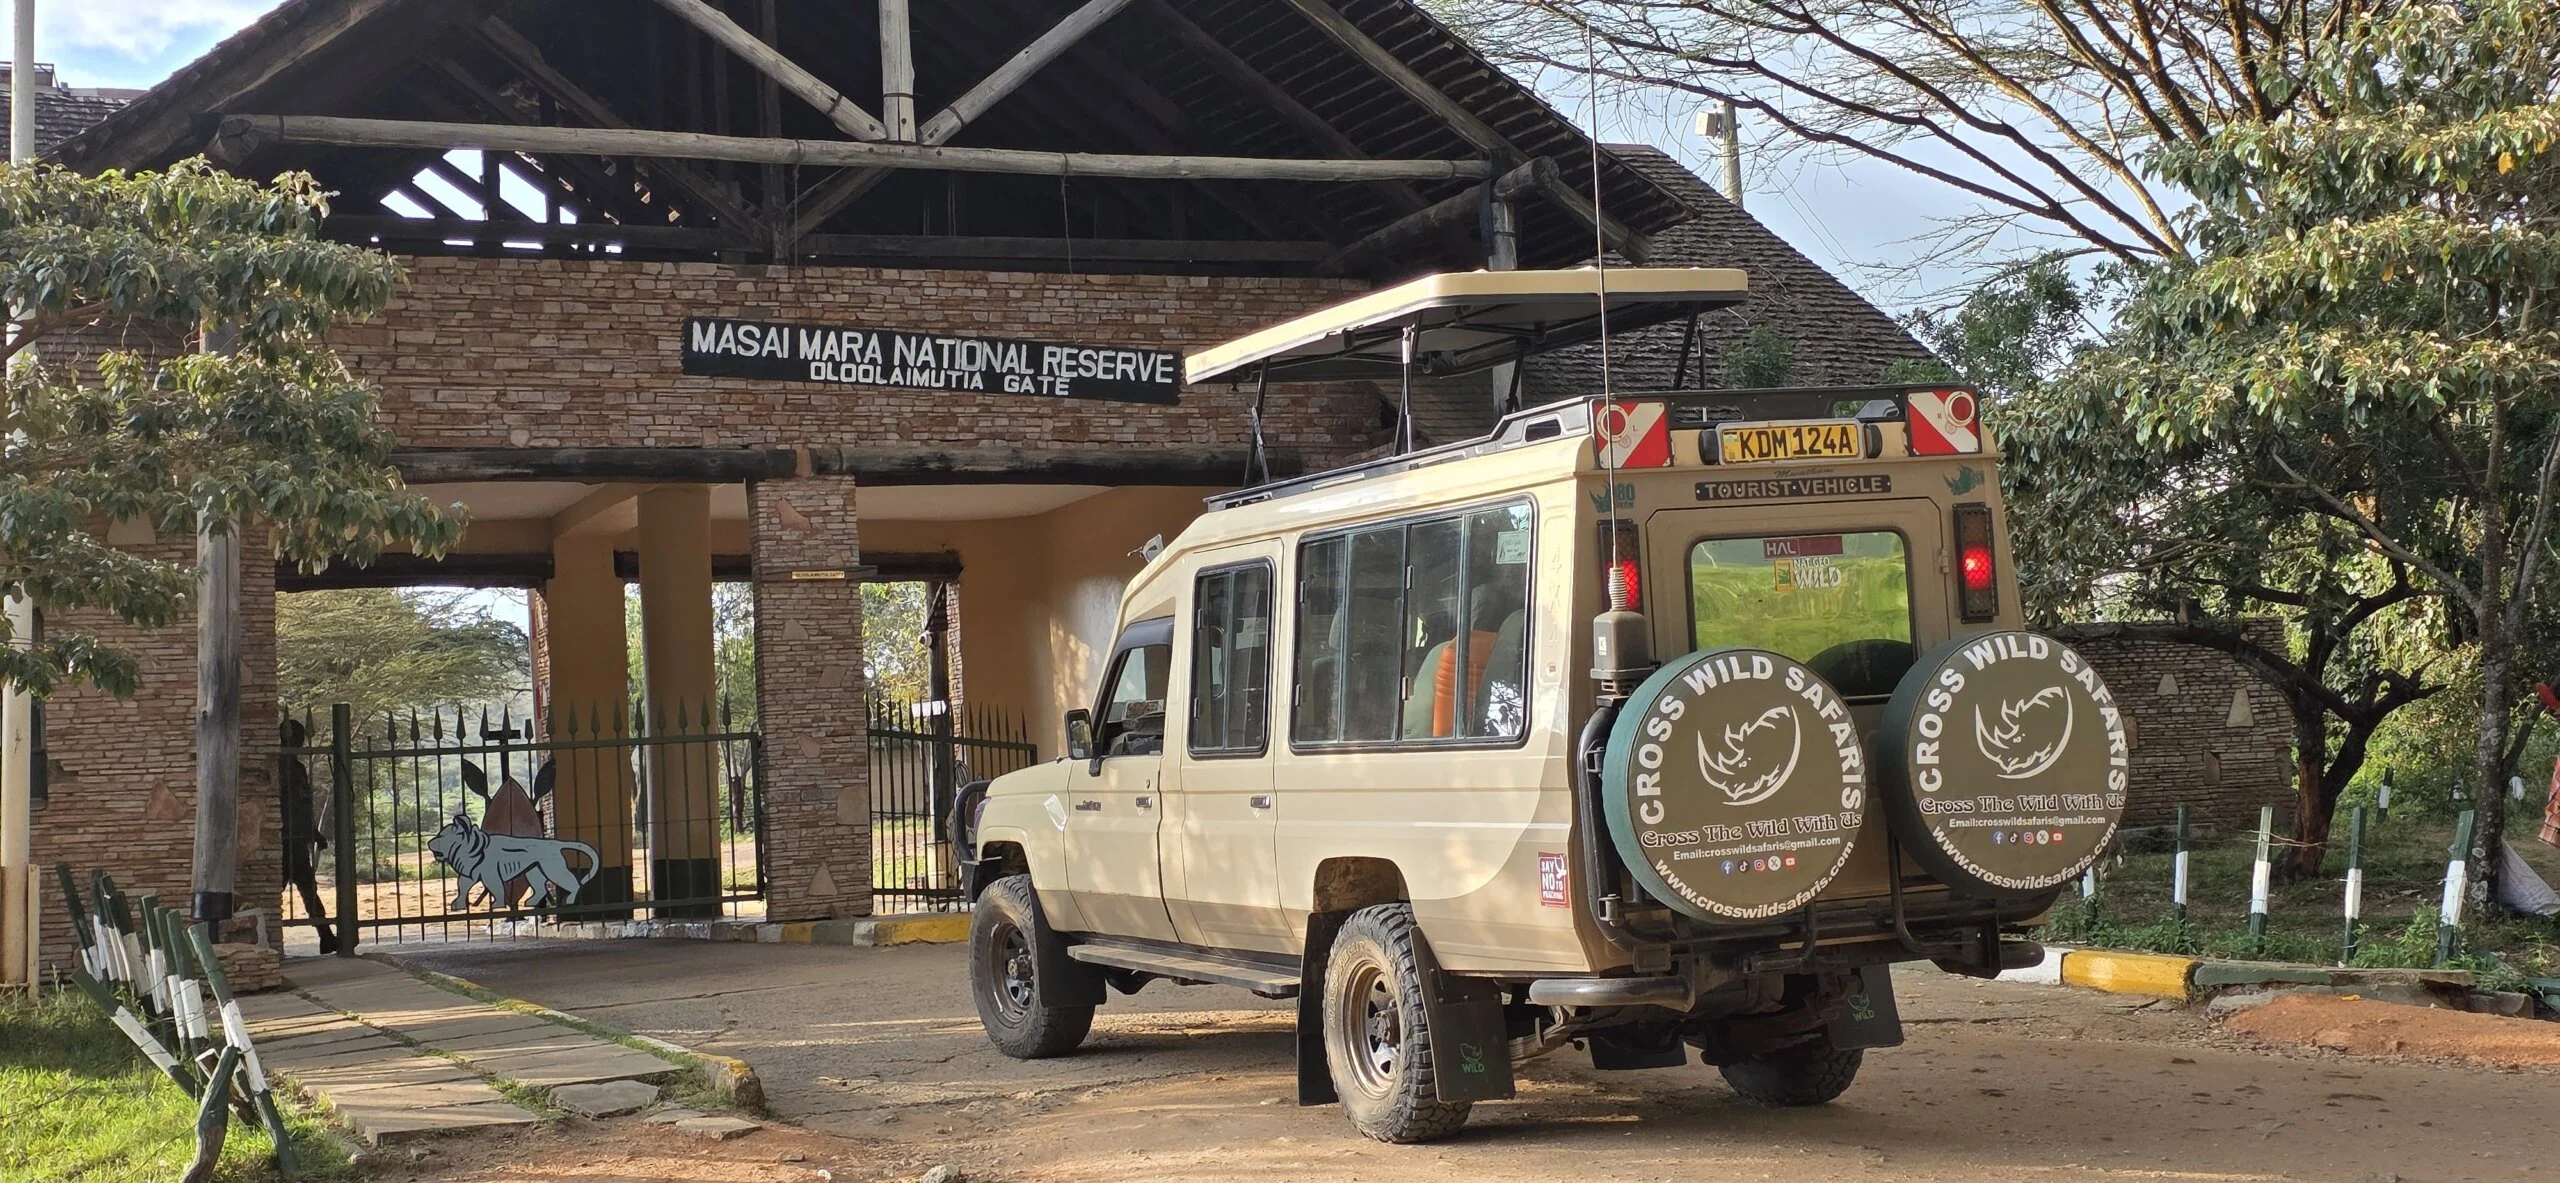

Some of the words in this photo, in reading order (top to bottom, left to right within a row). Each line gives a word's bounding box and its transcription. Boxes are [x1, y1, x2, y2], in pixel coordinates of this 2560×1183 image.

[692, 321, 789, 359] MASAI
[800, 328, 882, 365] MARA
[894, 334, 1033, 375] NATIONAL
[1043, 345, 1174, 384] RESERVE
[810, 361, 984, 390] OLOOLAIMUTIA
[1003, 375, 1070, 396] GATE
[1704, 481, 1791, 499] TOURIST
[1799, 477, 1883, 495] VEHICLE
[1793, 558, 1811, 569] NAT
[1812, 556, 1830, 568] GEO
[1793, 566, 1842, 590] WILD
[1916, 668, 1965, 792] CROSS
[1963, 635, 2049, 671] WILD
[2060, 650, 2128, 791] SAFARIS
[1637, 695, 1685, 825] CROSS
[1683, 655, 1773, 696] WILD
[1785, 666, 1862, 810] SAFARIS
[1919, 797, 1975, 815] Cross
[1977, 795, 2014, 812] The
[2016, 794, 2059, 812] Wild
[2062, 794, 2103, 811] With
[2106, 793, 2126, 810] Us
[1641, 830, 1700, 848] Cross
[1703, 825, 1741, 843] The
[1746, 818, 1789, 839] Wild
[1794, 813, 1837, 833] With
[1841, 811, 1863, 828] Us
[1541, 860, 1555, 873] SAY
[1931, 821, 2118, 890] www.crosswildsafaris.com
[1542, 873, 1556, 891] NO
[1556, 880, 1563, 891] TO
[1655, 841, 1854, 919] www.crosswildsafaris.com
[1853, 1009, 1875, 1022] WILD
[1462, 1063, 1485, 1073] WILD
